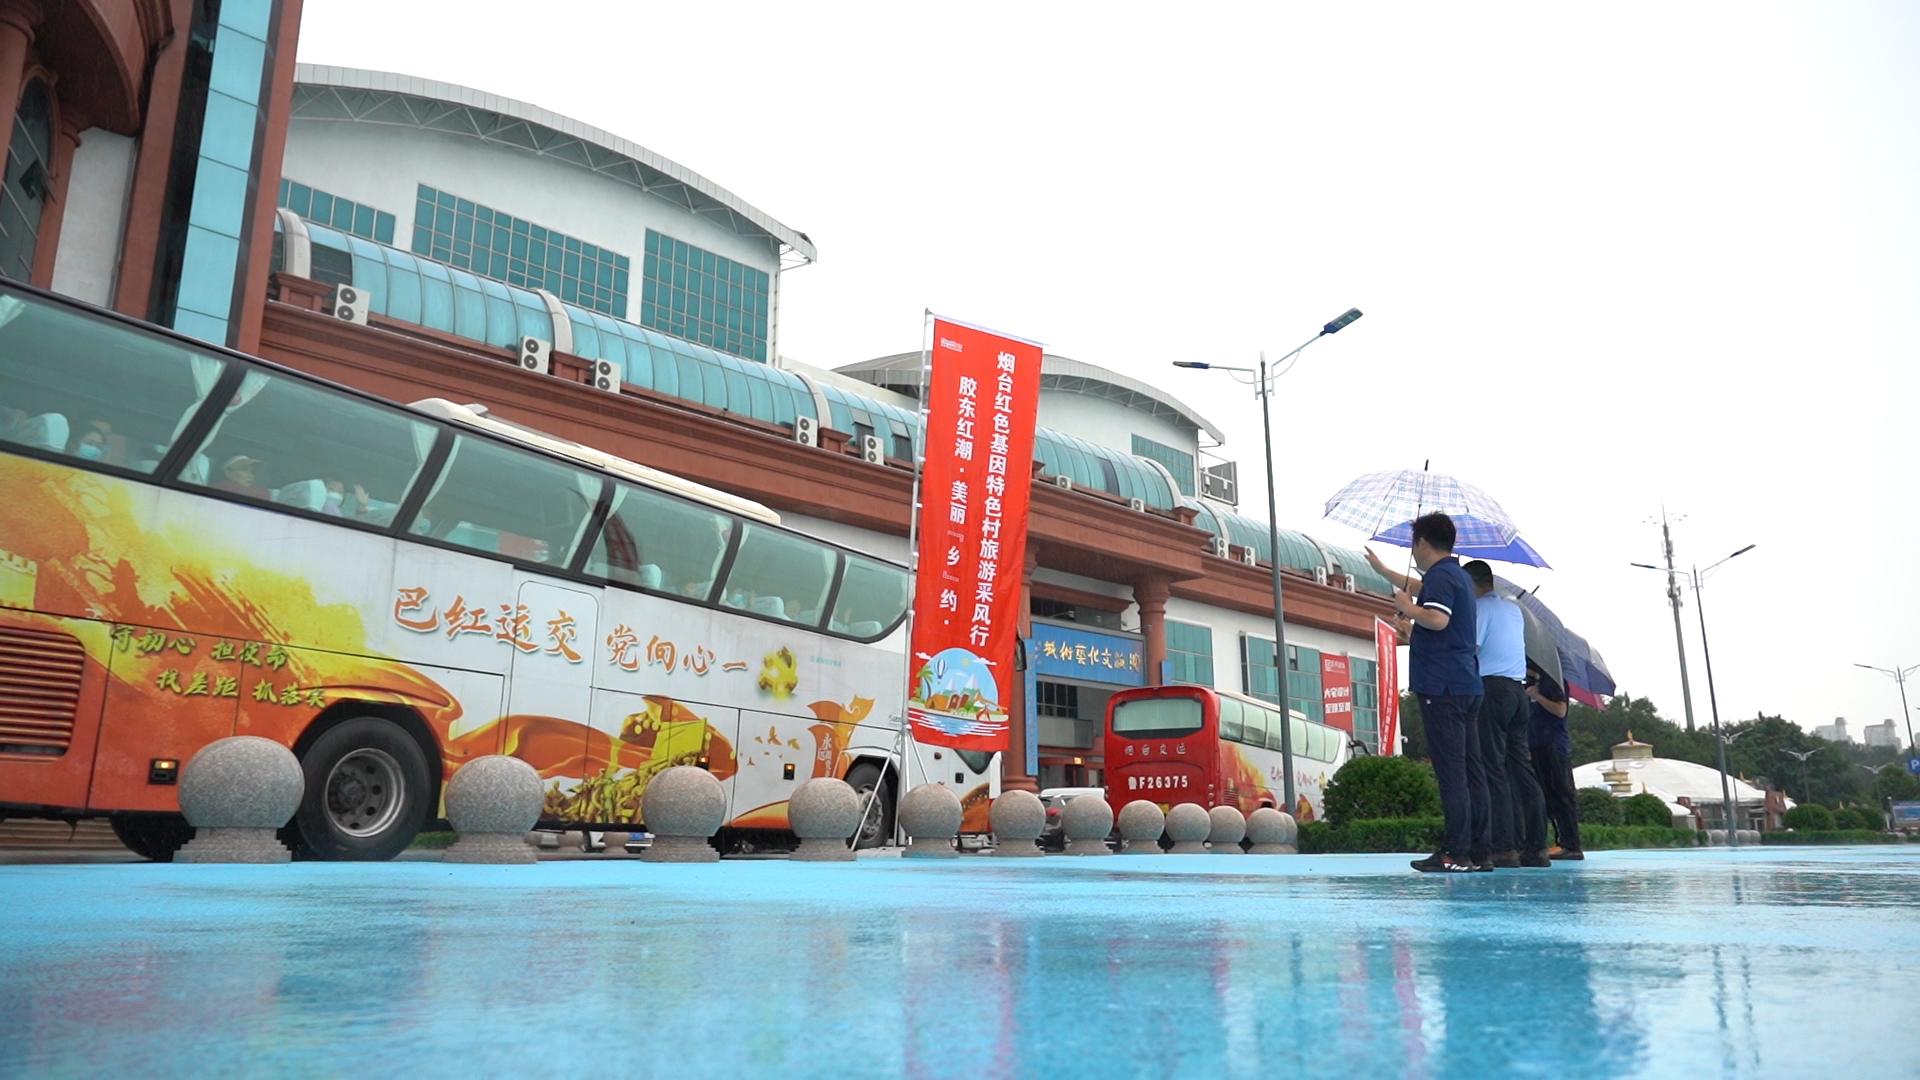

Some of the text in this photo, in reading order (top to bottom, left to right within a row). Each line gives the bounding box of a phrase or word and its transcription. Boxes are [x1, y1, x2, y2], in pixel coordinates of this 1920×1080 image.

[969, 351, 1016, 647] 烟台红色基因特色村旅游采风行
[1910, 759, 1920, 771] P
